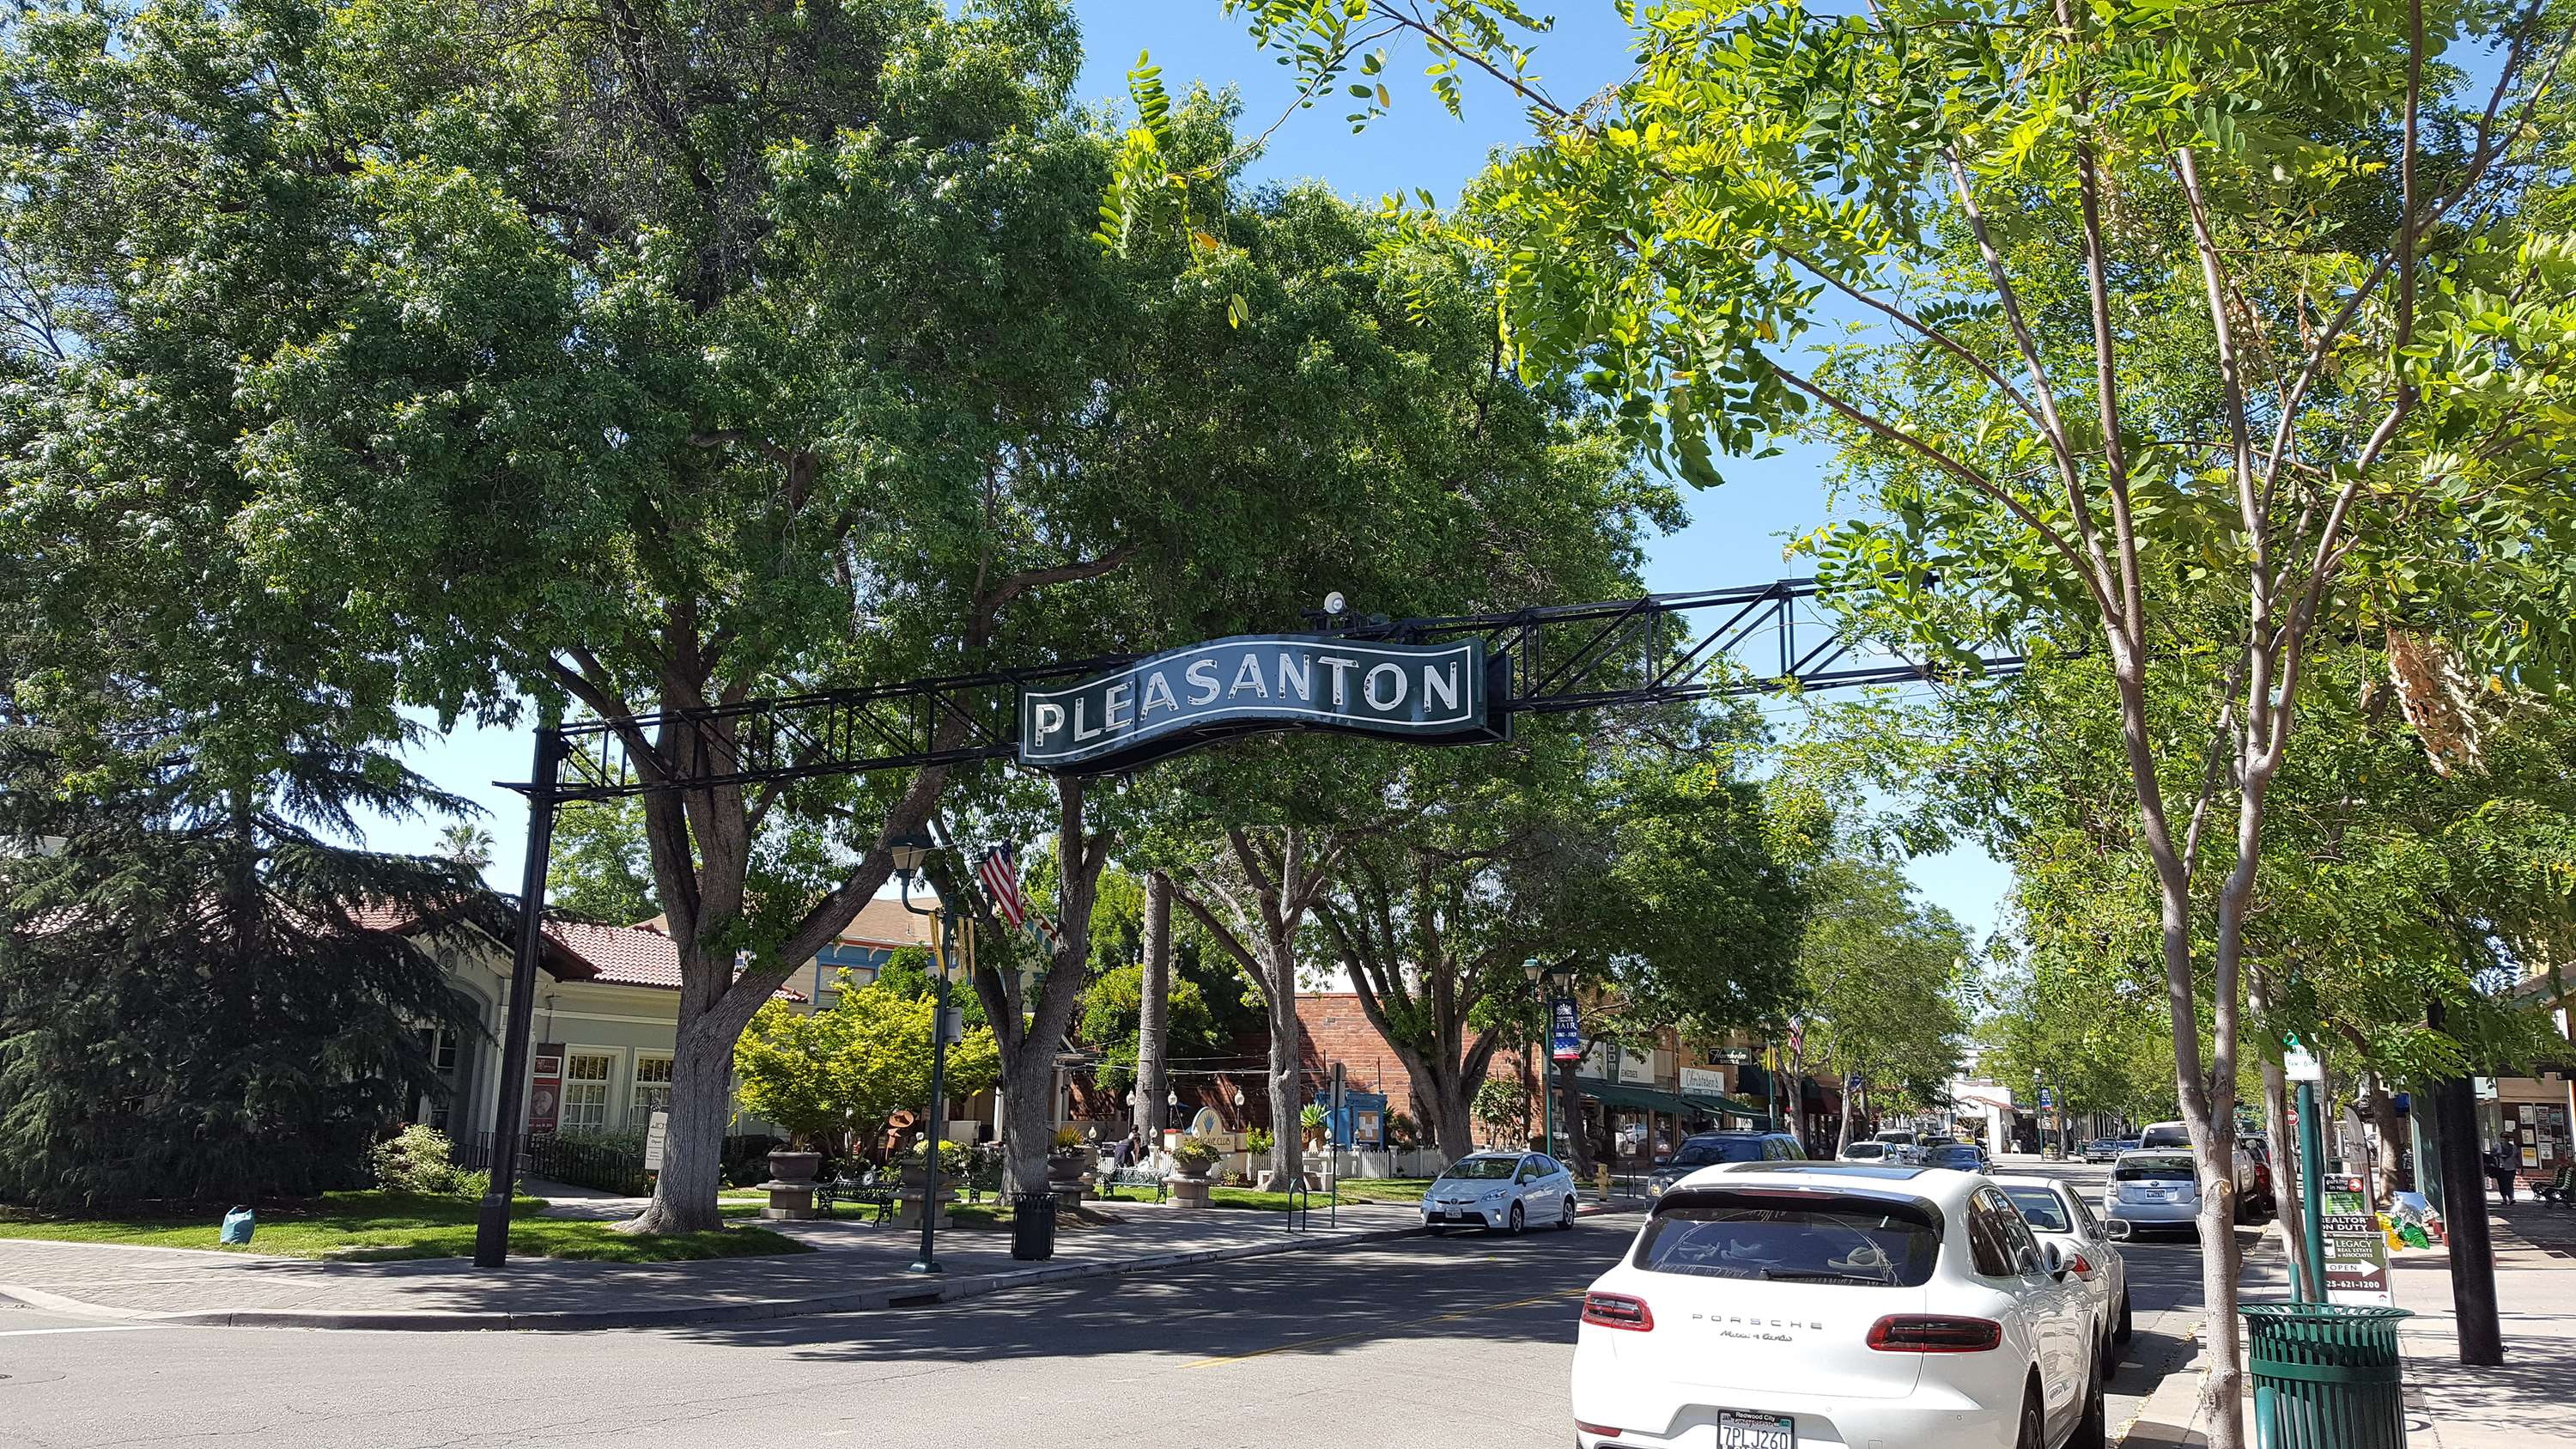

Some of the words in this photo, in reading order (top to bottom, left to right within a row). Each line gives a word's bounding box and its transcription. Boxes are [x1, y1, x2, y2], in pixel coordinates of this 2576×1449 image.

[1035, 653, 1458, 747] PLEASANTON
[2336, 1239, 2372, 1248] LEGACY
[2326, 1280, 2380, 1288] 25-621-1200
[1692, 1313, 1823, 1330] PORSCHE
[1735, 1411, 1763, 1420] Redwood
[1723, 1427, 1788, 1449] 7PLJ260
